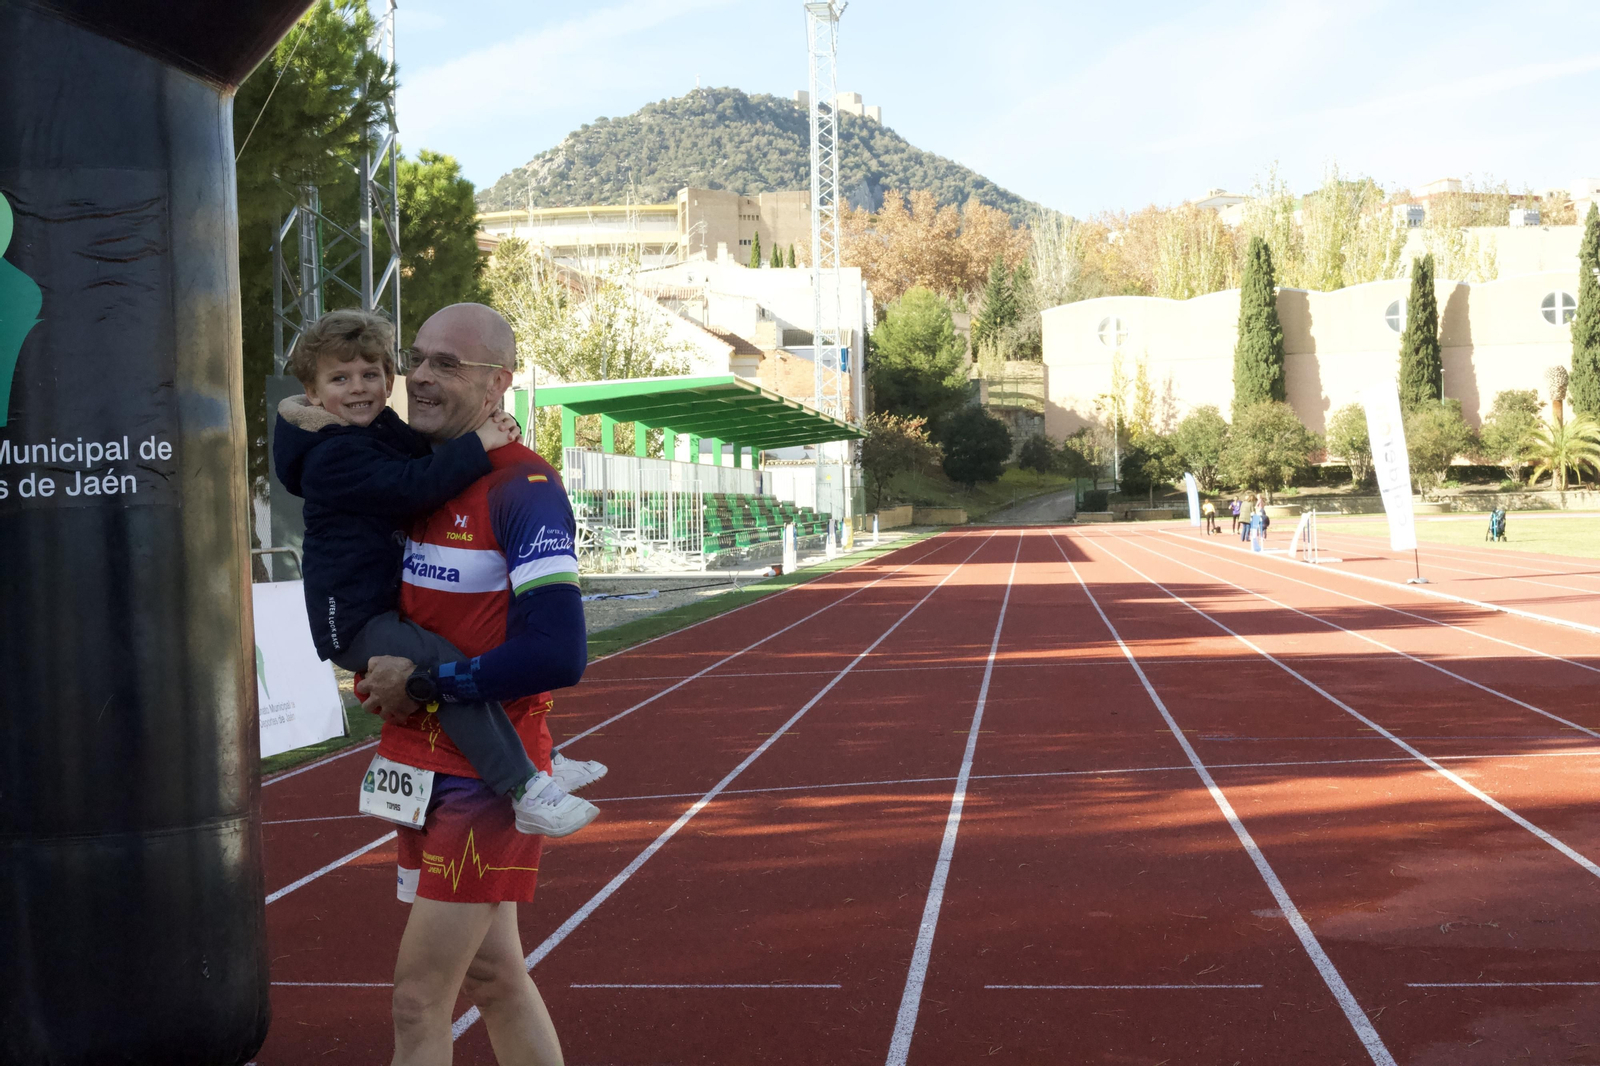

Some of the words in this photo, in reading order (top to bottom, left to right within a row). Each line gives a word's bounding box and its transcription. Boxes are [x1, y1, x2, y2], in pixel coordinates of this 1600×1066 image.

[139, 435, 173, 460] de
[18, 473, 56, 498] de
[65, 467, 137, 497] Jaén
[446, 530, 473, 542] TOMÁS
[403, 553, 460, 583] Avanza
[328, 596, 336, 616] NEVER
[328, 616, 337, 633] LOOK
[331, 633, 341, 650] BACK
[377, 768, 413, 797] 206
[386, 801, 401, 812] TOMAS
